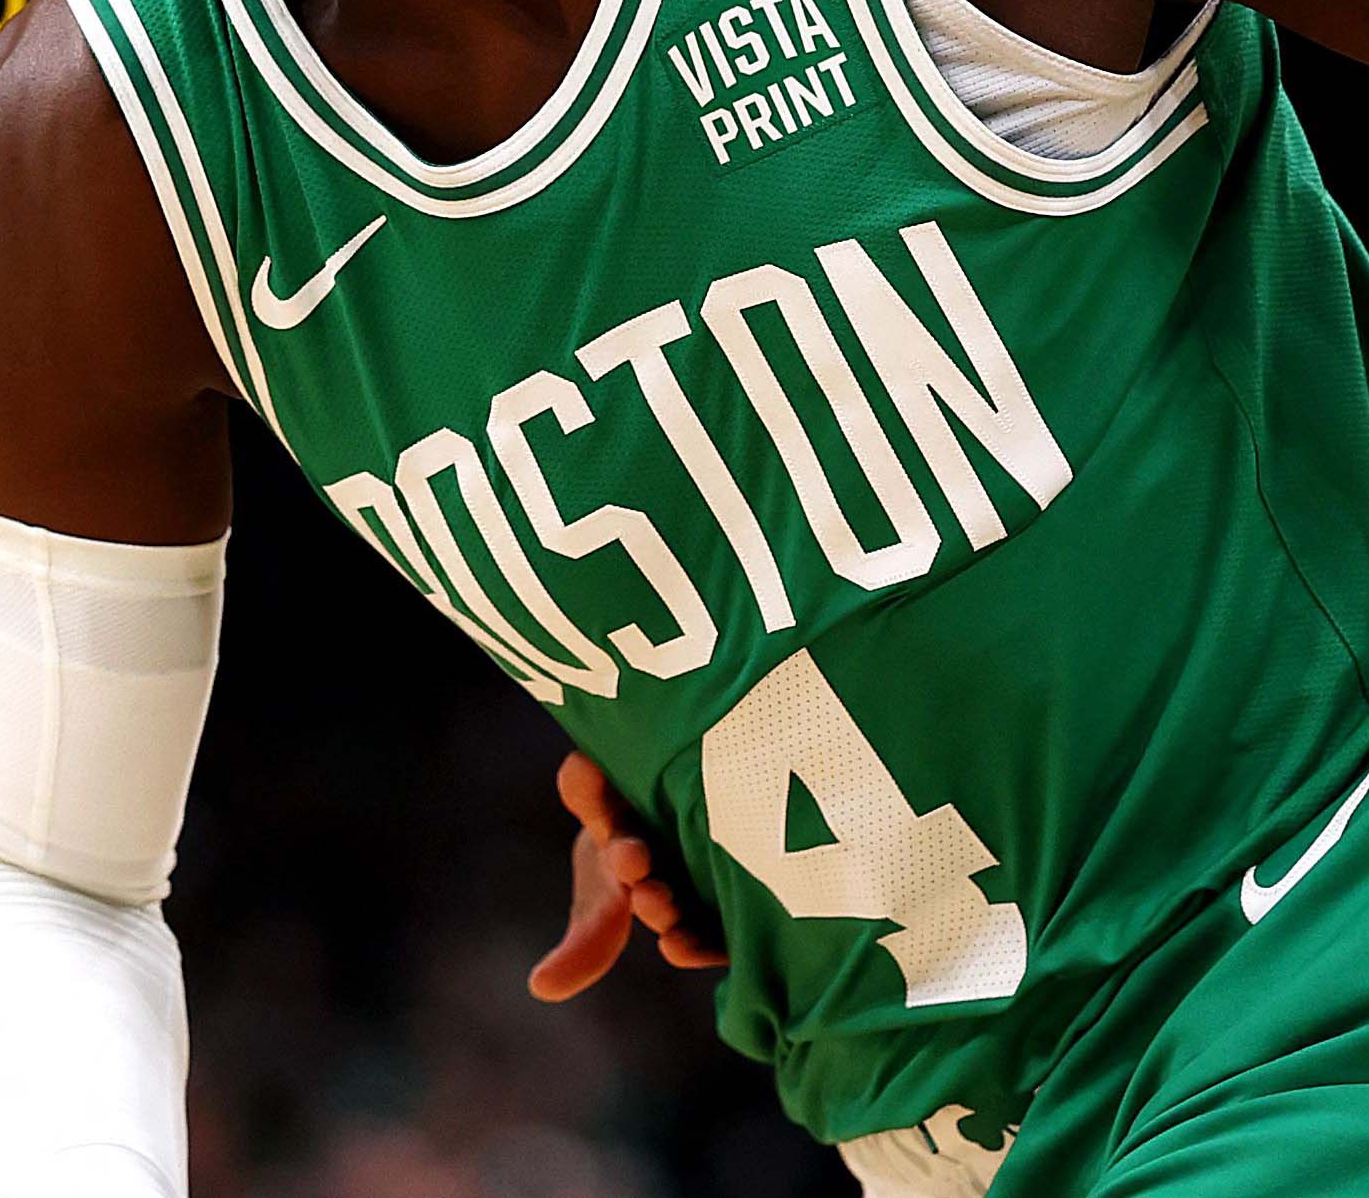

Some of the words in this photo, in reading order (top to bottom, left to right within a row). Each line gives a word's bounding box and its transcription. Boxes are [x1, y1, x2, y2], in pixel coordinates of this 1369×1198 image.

[699, 51, 856, 165] PRINT
[322, 221, 1075, 706] BOSTON
[702, 648, 1030, 1009] 4
